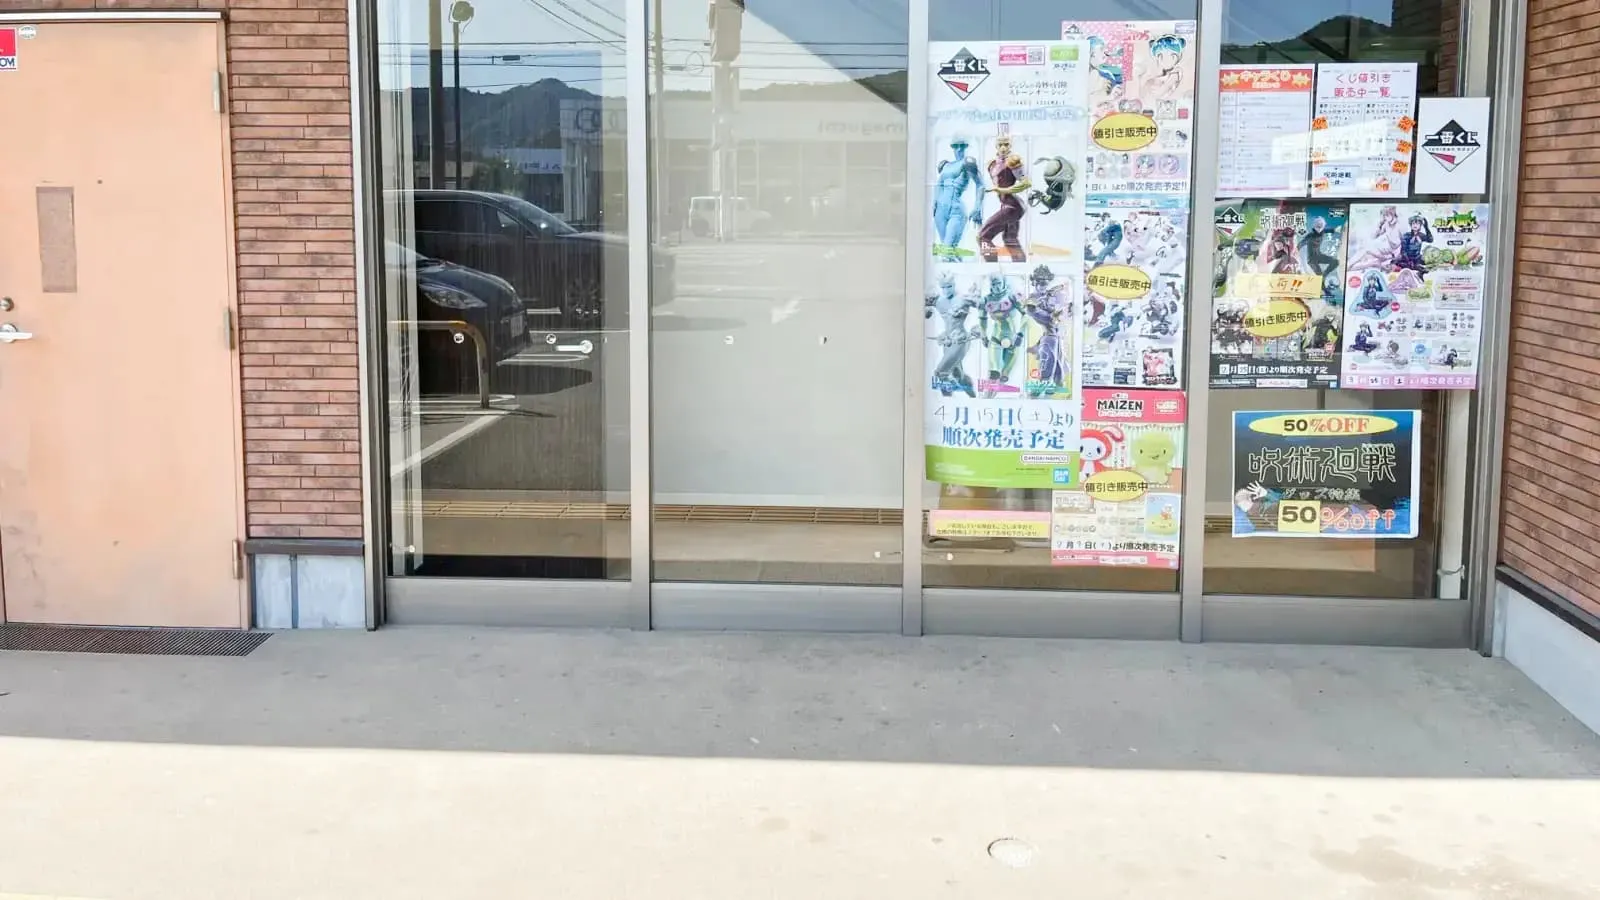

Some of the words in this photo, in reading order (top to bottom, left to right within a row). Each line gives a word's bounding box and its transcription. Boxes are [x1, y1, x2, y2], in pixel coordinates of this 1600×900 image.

[940, 58, 988, 72] 一番くじ
[1336, 73, 1391, 83] くじ値引き
[1334, 86, 1391, 97] 販売中一覧
[1094, 126, 1156, 139] 値引き販売中
[1425, 131, 1478, 144] 一番くじ
[1215, 214, 1245, 223] 一番くじ
[1088, 274, 1151, 290] 値引き販売中
[1244, 311, 1308, 327] 値引き販売中
[1097, 400, 1143, 410] MAIZEN
[942, 426, 1065, 450] 順次発売予定
[1248, 443, 1397, 483] 呪術廻戦
[1085, 482, 1149, 493] 値引き販売中
